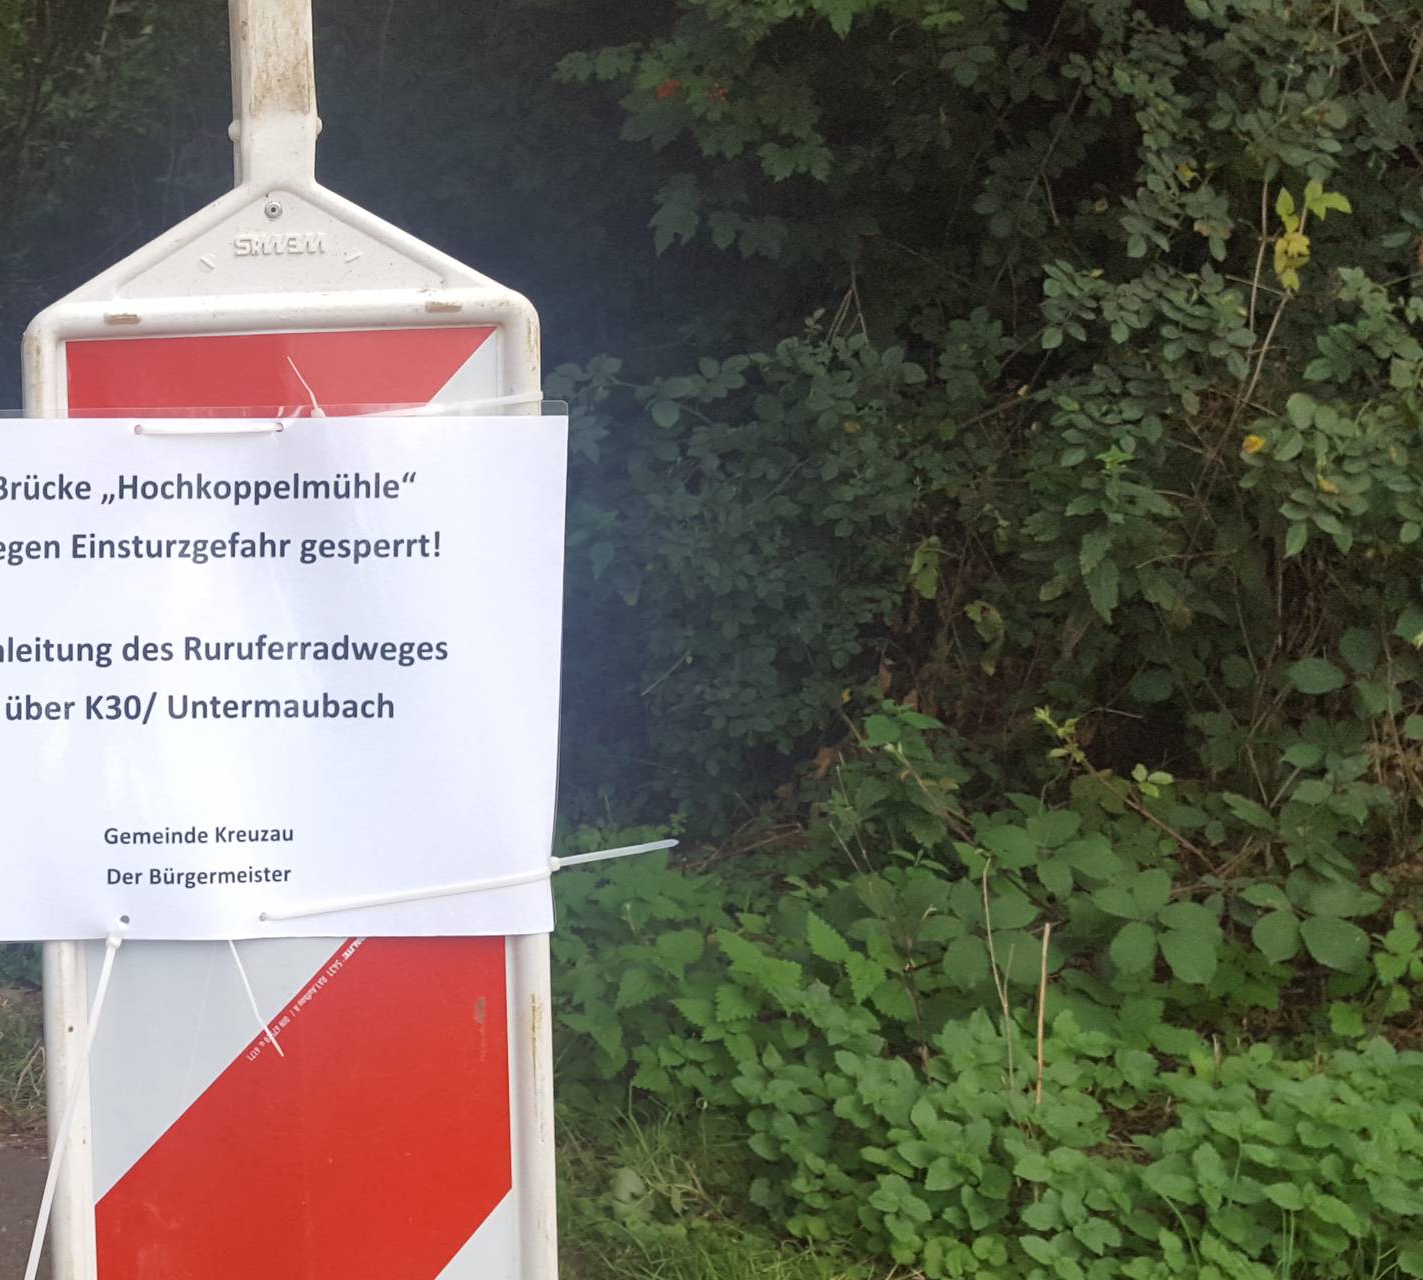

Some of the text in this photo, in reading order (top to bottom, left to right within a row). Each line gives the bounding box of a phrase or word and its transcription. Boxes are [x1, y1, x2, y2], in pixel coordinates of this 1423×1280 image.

[100, 471, 417, 506] „Hochkoppelmühle“
[71, 531, 292, 565] Einsturzgefahr
[299, 530, 441, 565] gesperrt!
[122, 634, 174, 662] des
[184, 633, 448, 668] Ruruferradweges
[5, 691, 395, 725] über K30/ Untermaubach
[103, 826, 294, 845] Gemeinde Kreuzau
[107, 865, 292, 889] Der Bürgermeister
